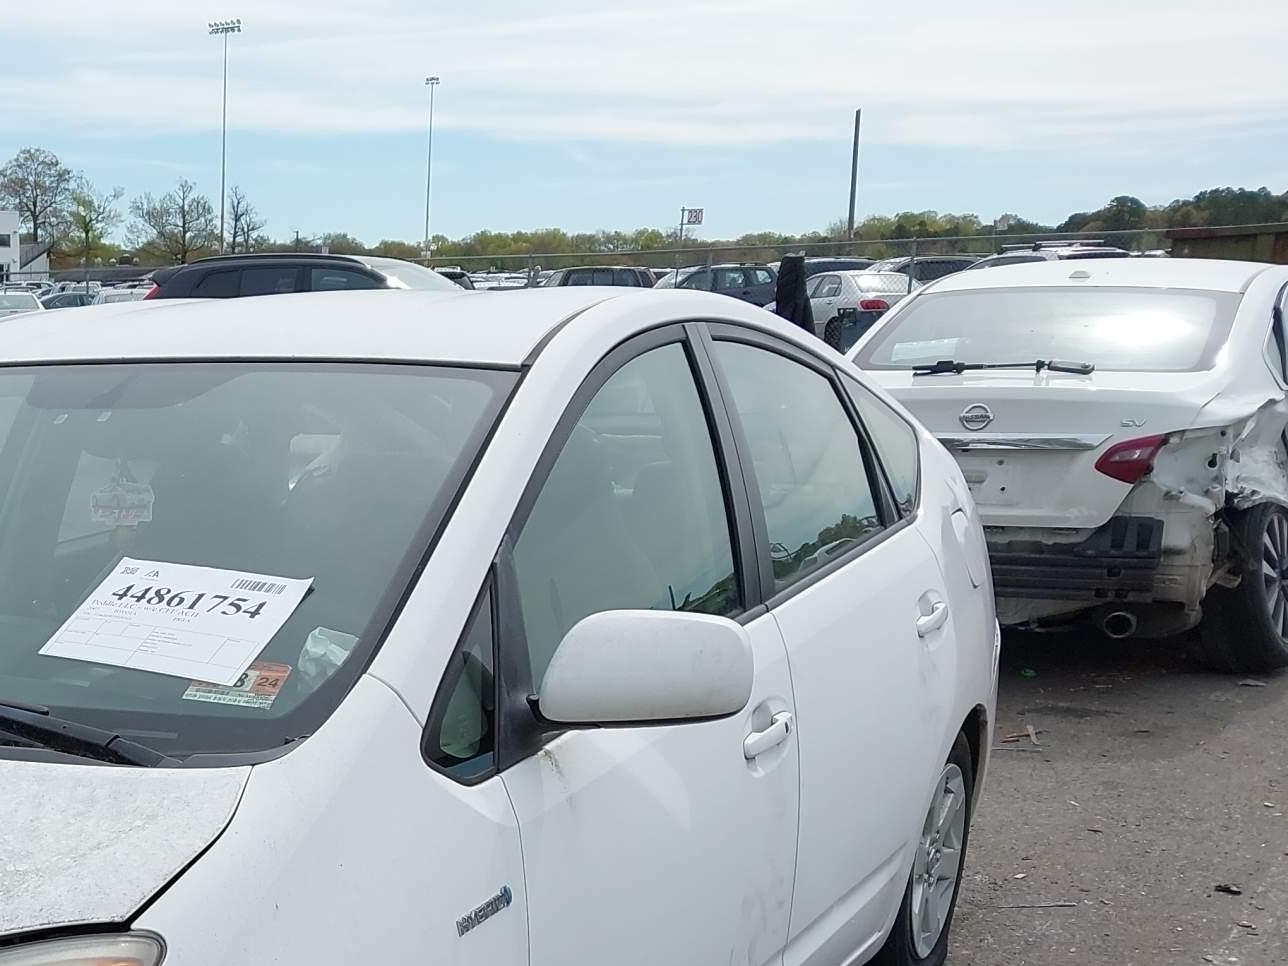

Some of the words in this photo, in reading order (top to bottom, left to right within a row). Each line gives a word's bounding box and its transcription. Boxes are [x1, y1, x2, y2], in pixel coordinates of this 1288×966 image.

[1120, 419, 1146, 428] SV
[112, 583, 268, 619] 44861754
[256, 676, 280, 689] 24
